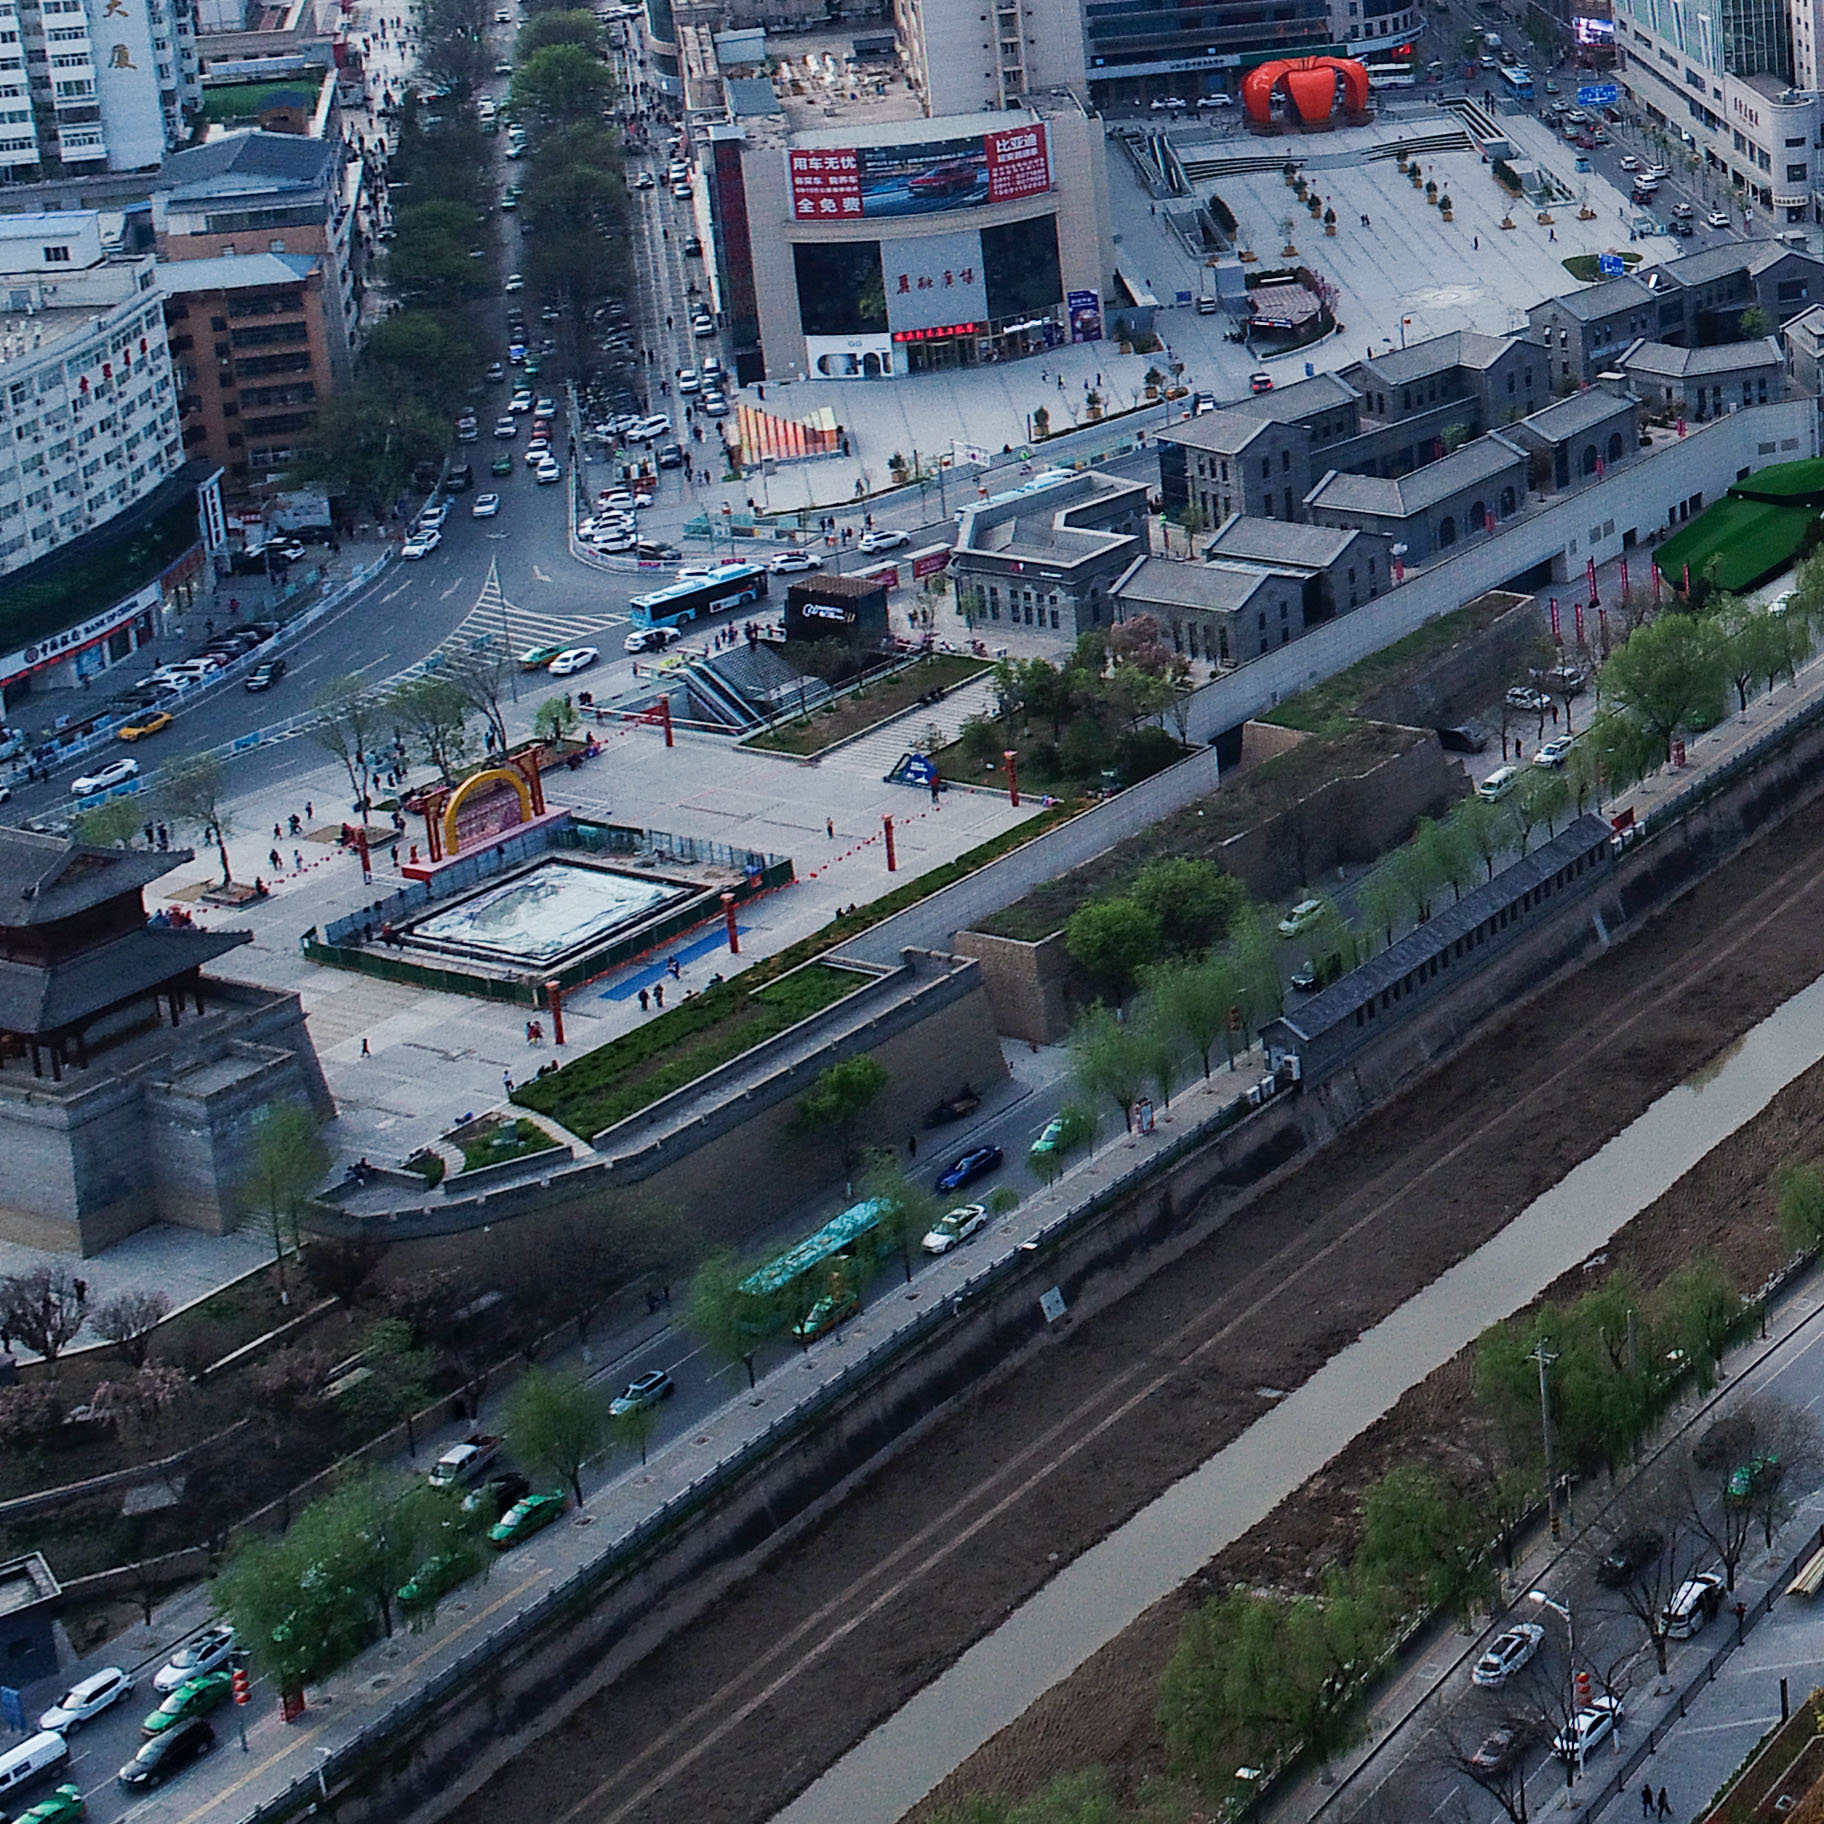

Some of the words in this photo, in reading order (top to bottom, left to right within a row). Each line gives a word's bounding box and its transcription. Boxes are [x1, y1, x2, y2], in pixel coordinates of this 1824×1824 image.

[996, 133, 1038, 153] 比亚迪
[793, 156, 857, 171] 用车无忧
